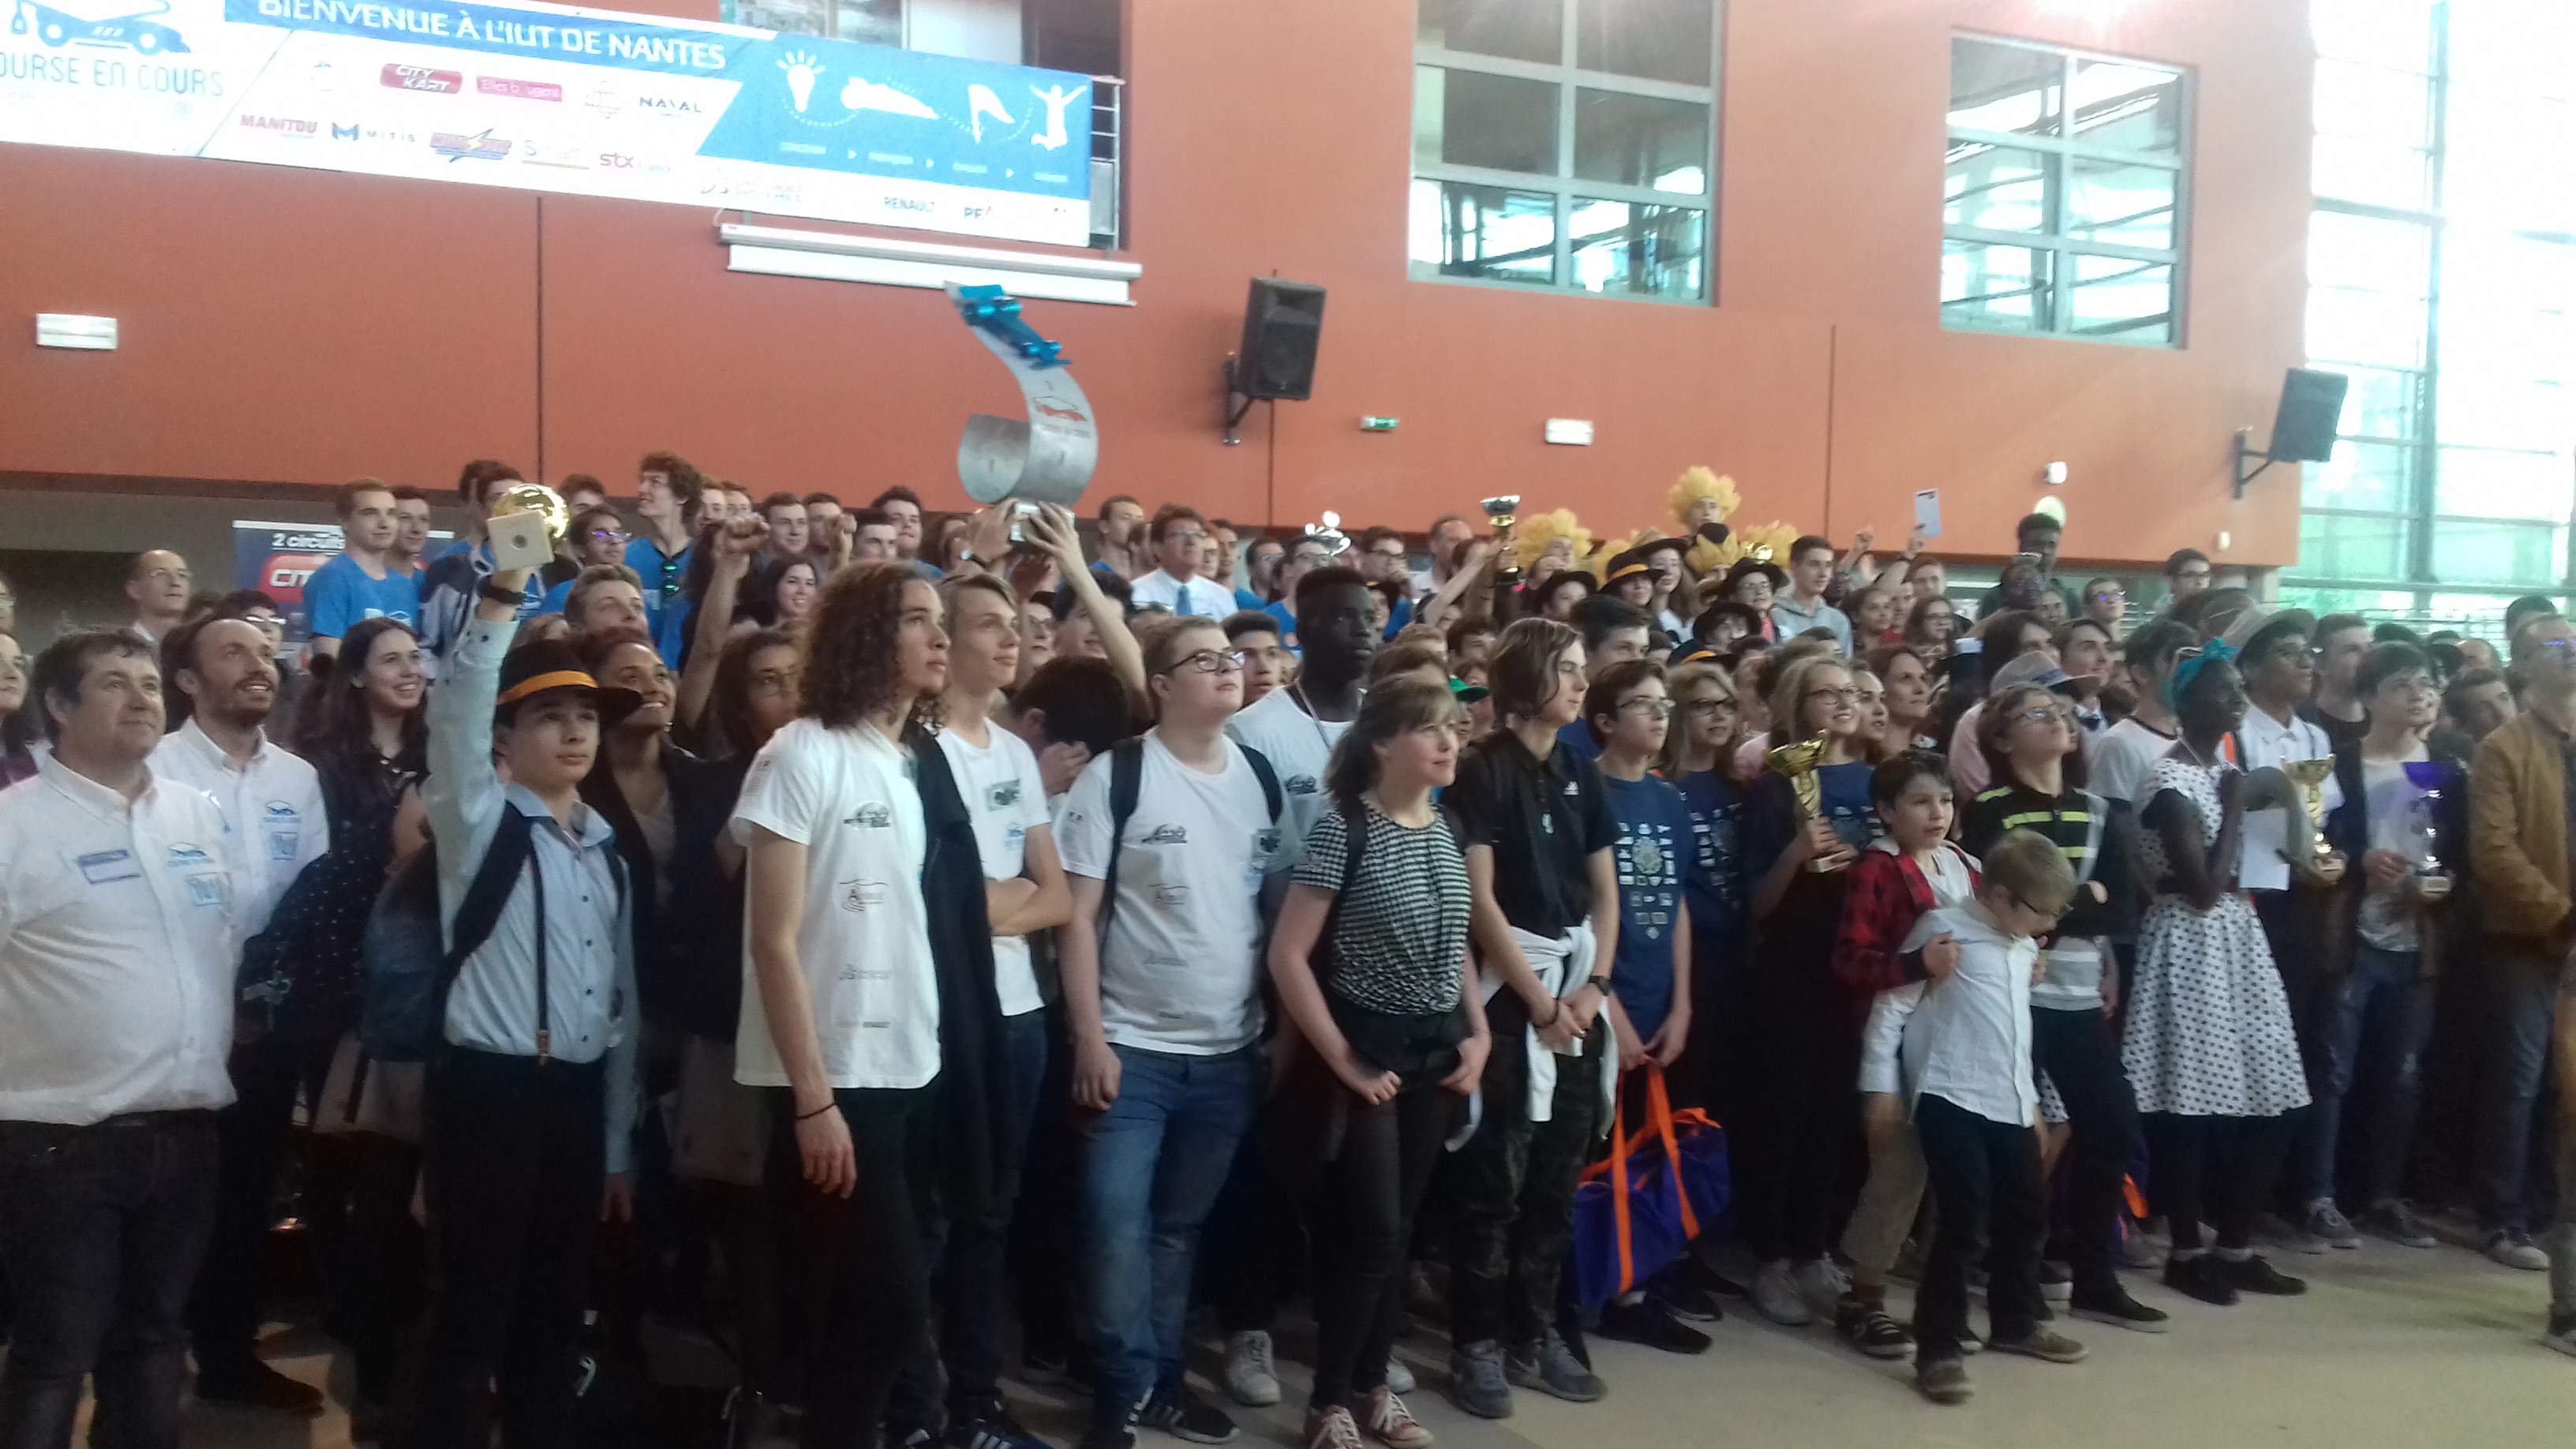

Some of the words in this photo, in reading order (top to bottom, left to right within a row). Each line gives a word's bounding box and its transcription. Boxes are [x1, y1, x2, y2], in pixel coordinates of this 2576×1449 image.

[259, 0, 450, 36] BIENVENUE
[455, 9, 481, 39] À
[485, 20, 556, 48] L'IUT
[561, 28, 602, 55] DE
[609, 33, 727, 69] NANTES
[137, 64, 224, 96] COURS
[396, 65, 434, 77] CITY
[402, 77, 451, 92] KART
[638, 96, 702, 114] NAVAL
[239, 114, 318, 133] MANITOU
[271, 533, 286, 548] 2
[270, 568, 317, 588] CIT
